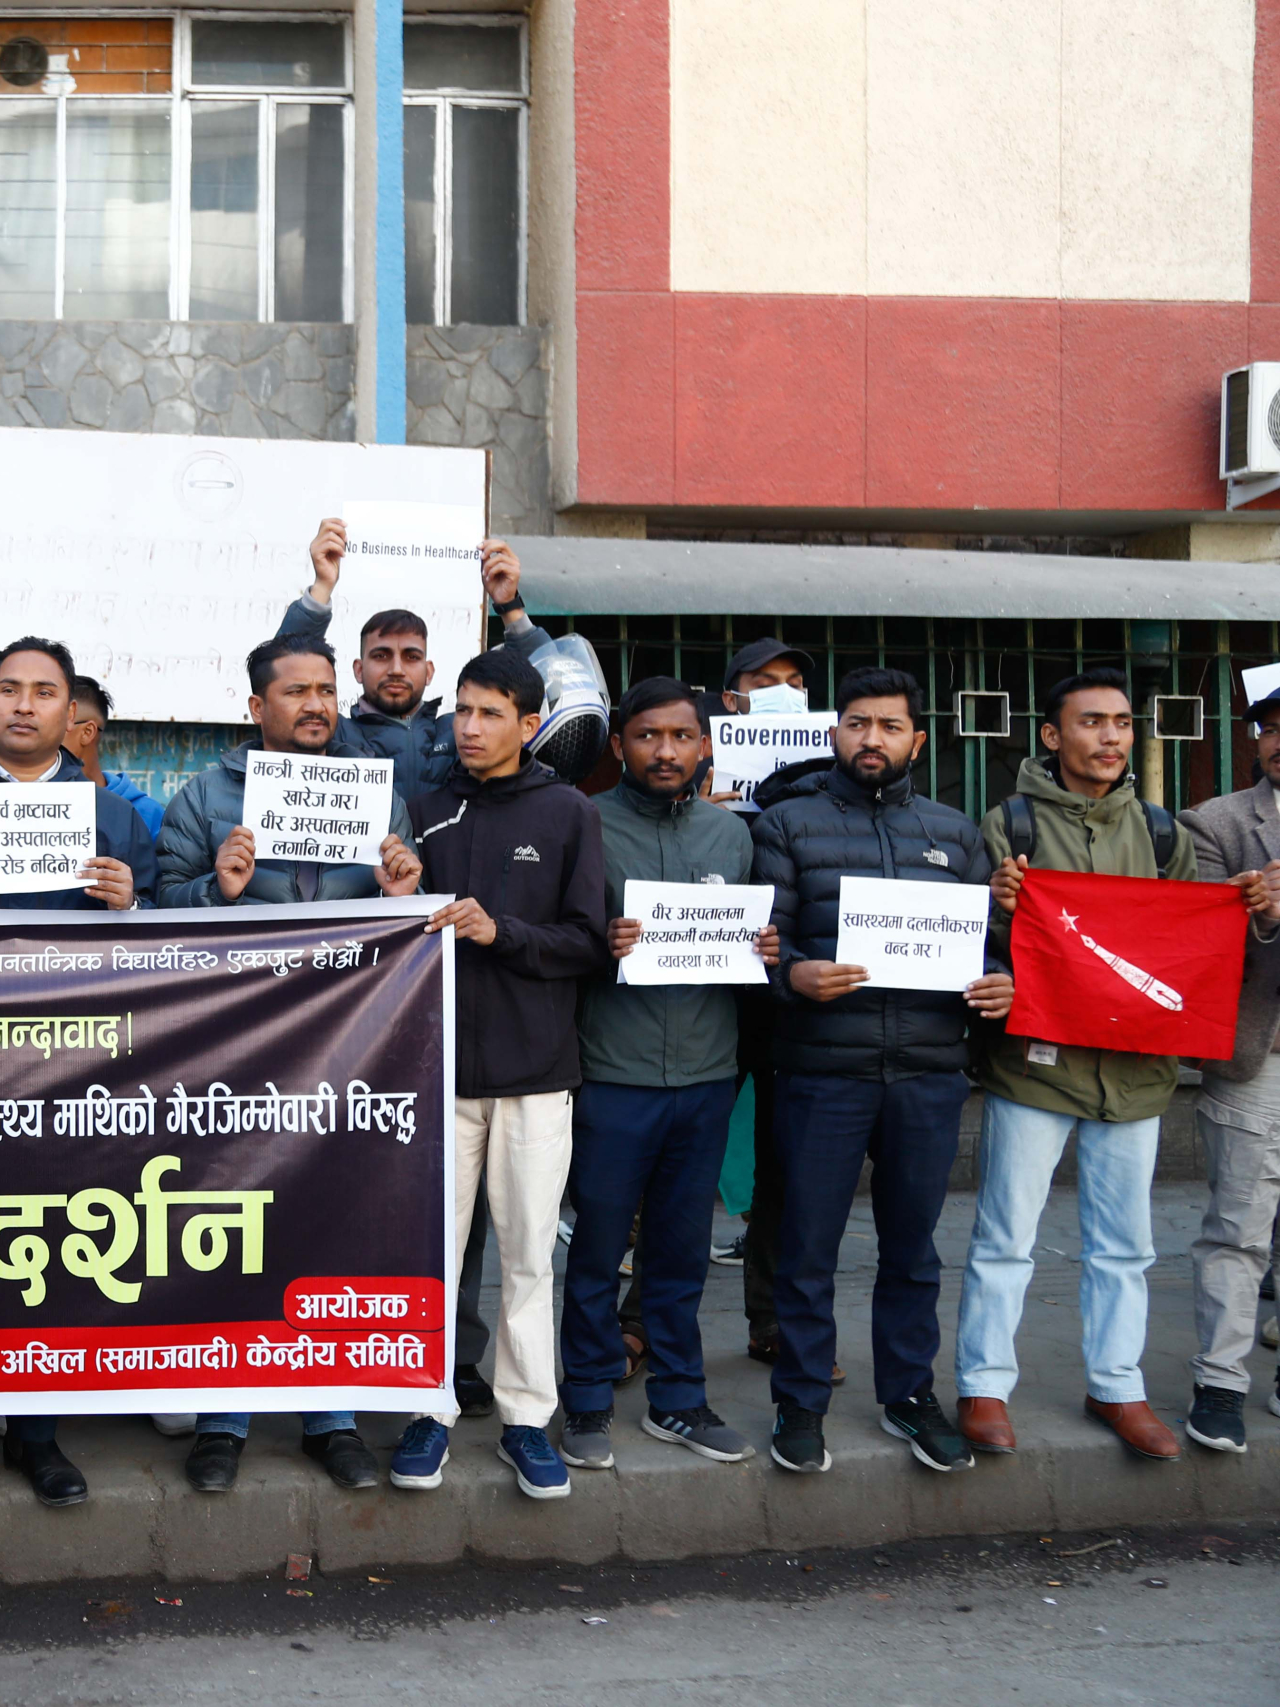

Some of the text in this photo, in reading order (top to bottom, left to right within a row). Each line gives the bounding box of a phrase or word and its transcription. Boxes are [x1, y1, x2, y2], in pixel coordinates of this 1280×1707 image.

[361, 540, 408, 557] Business
[411, 543, 421, 557] In
[424, 544, 481, 561] Healthcare
[719, 722, 832, 747] Governmen
[300, 763, 361, 784] सांसदको
[282, 786, 359, 811] खारेज गर।
[13, 803, 72, 821] भ्रष्टाचार
[260, 809, 370, 836] वीर अस्पतालमा
[0, 826, 92, 849] अस्पताललाई
[271, 837, 321, 857] लगानि
[324, 844, 348, 860] गर
[651, 902, 745, 921] वीर अस्पतालमा
[842, 912, 984, 935] स्वास्थ्यमा दलालीकरण
[657, 954, 729, 969] व्यवस्था गर।
[884, 941, 910, 957] वन्द
[912, 943, 933, 959] गर
[227, 947, 303, 977] एकजुट
[54, 1084, 157, 1140] माथिको
[166, 1081, 337, 1137] गैरजिम्मेवारी
[293, 1285, 410, 1321] आयोजक
[0, 1333, 428, 1376] अखिल (समाजवादी) केन्द्रीय समिति
